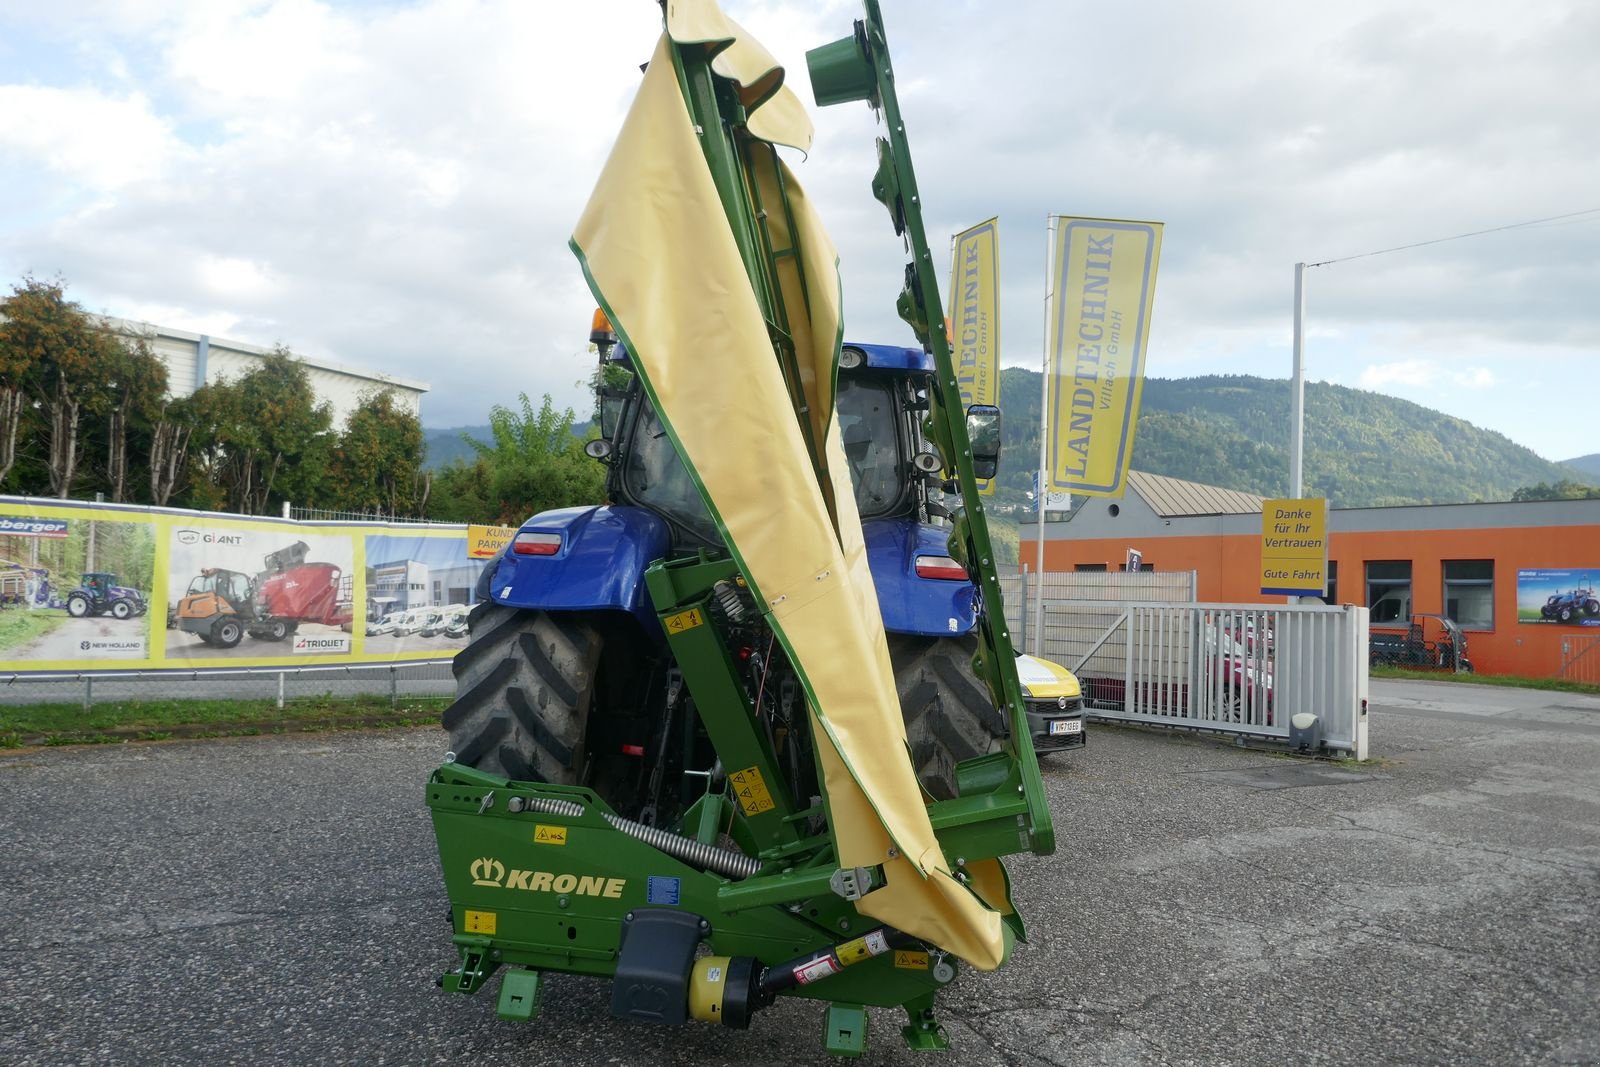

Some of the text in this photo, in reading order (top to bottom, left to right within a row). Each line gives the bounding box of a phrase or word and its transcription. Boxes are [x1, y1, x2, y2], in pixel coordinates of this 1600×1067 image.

[956, 239, 979, 409] DTECHNIK
[979, 311, 987, 354] GmbH
[1065, 233, 1115, 479] LANDTECHNIK
[1100, 310, 1122, 411] Villach GmbH
[1275, 508, 1312, 519] Danke
[0, 519, 65, 532] berger
[1274, 522, 1311, 533] für Ihr
[486, 528, 516, 538] KUND
[1264, 537, 1322, 548] Vertrauen
[1263, 569, 1321, 580] Gute Fahrt
[505, 869, 626, 899] KRONE
